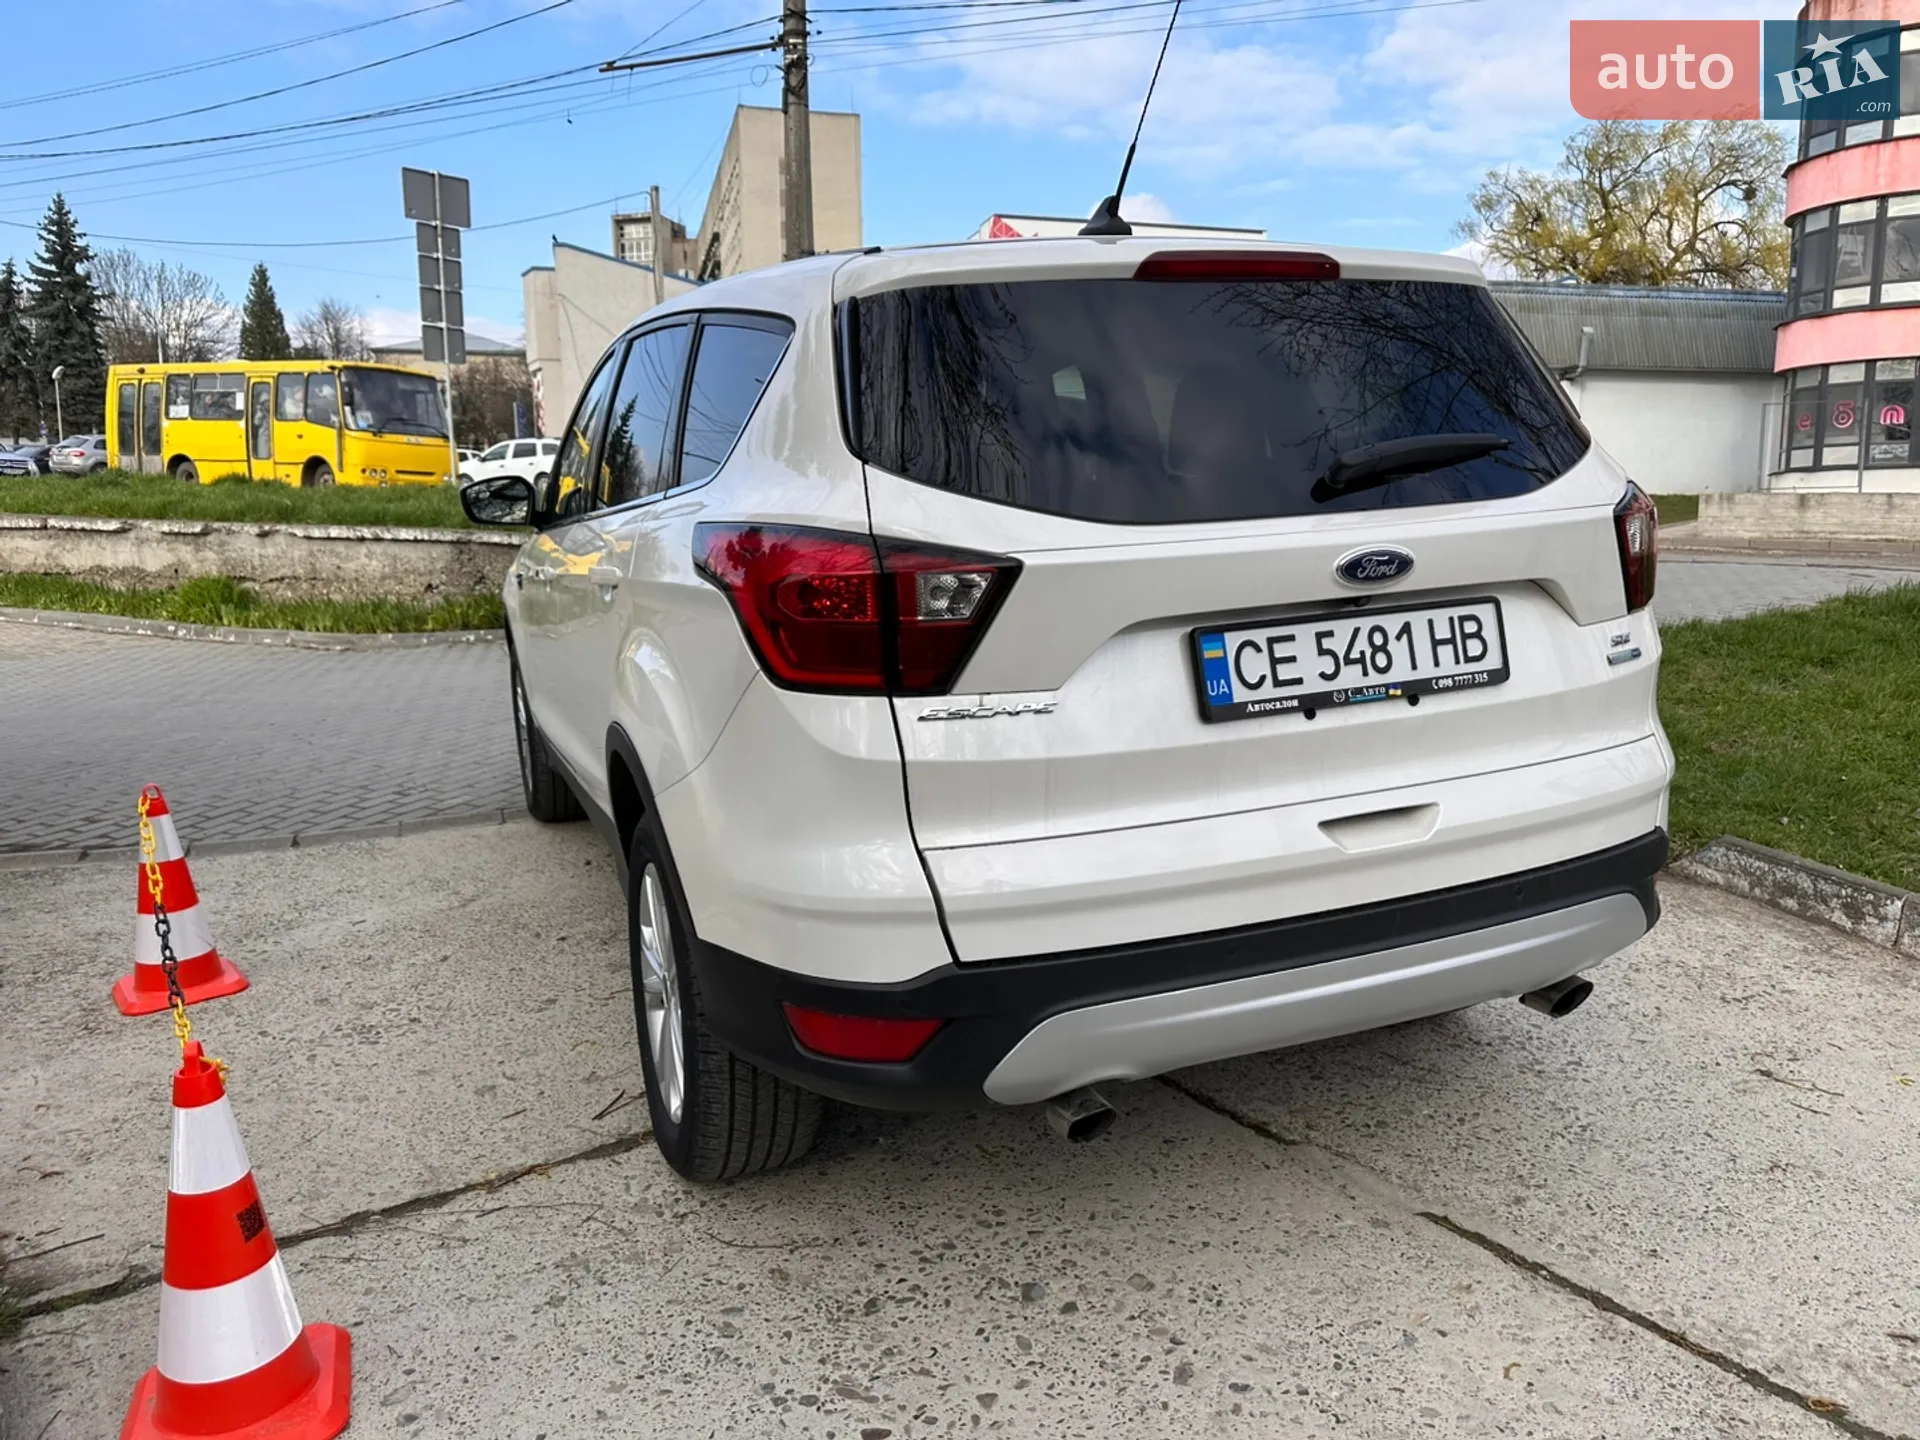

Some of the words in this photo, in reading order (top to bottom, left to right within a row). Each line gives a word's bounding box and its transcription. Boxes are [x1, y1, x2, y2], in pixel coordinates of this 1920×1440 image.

[1357, 555, 1399, 579] Ford
[1234, 634, 1304, 691] CE
[1315, 621, 1418, 682] 5481
[1428, 614, 1488, 668] HB
[1207, 678, 1230, 696] UA
[1246, 699, 1299, 713] Автосалон
[1474, 672, 1489, 684] 315
[917, 701, 1059, 722] ESCAPE
